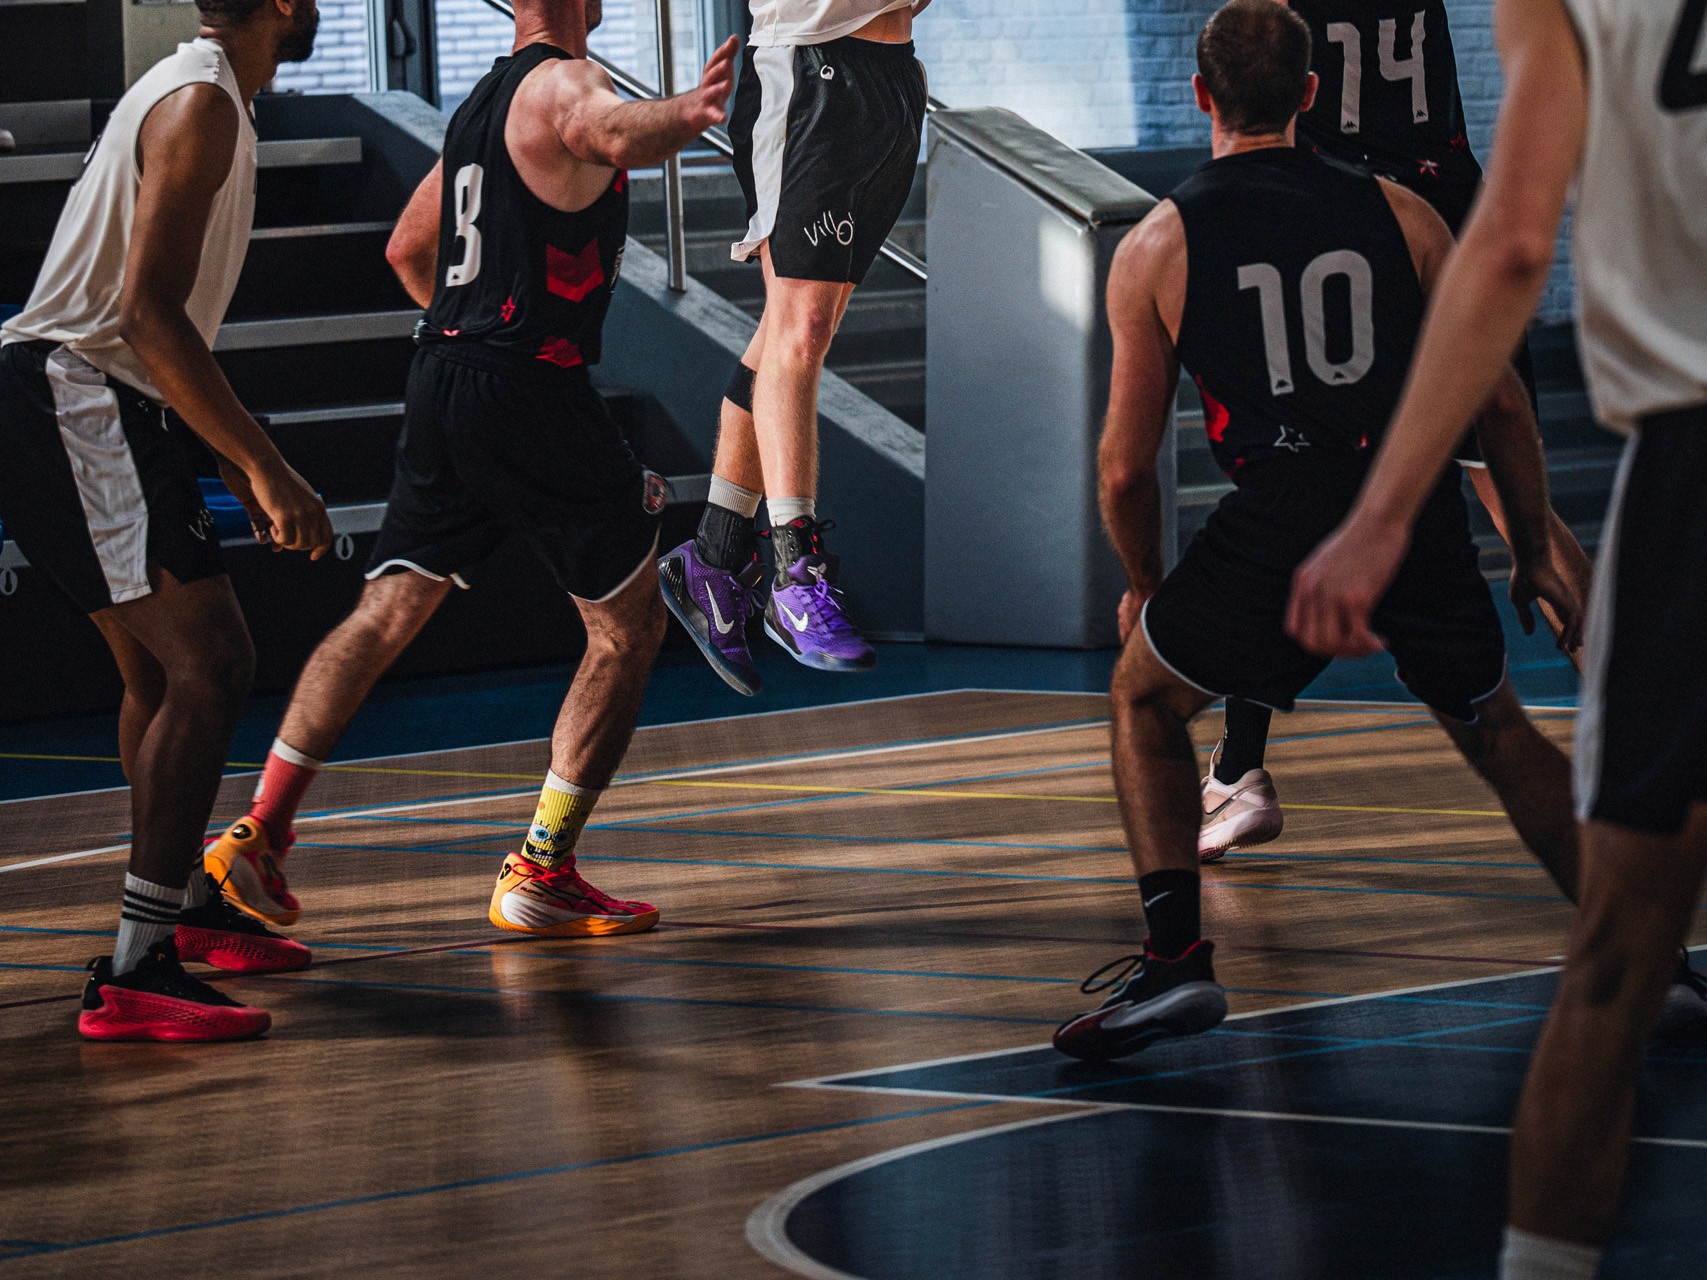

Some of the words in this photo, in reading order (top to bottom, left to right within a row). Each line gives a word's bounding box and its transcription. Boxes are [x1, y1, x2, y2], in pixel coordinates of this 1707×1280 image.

[1326, 9, 1429, 134] 14
[446, 163, 484, 287] 3
[1237, 249, 1374, 396] 10
